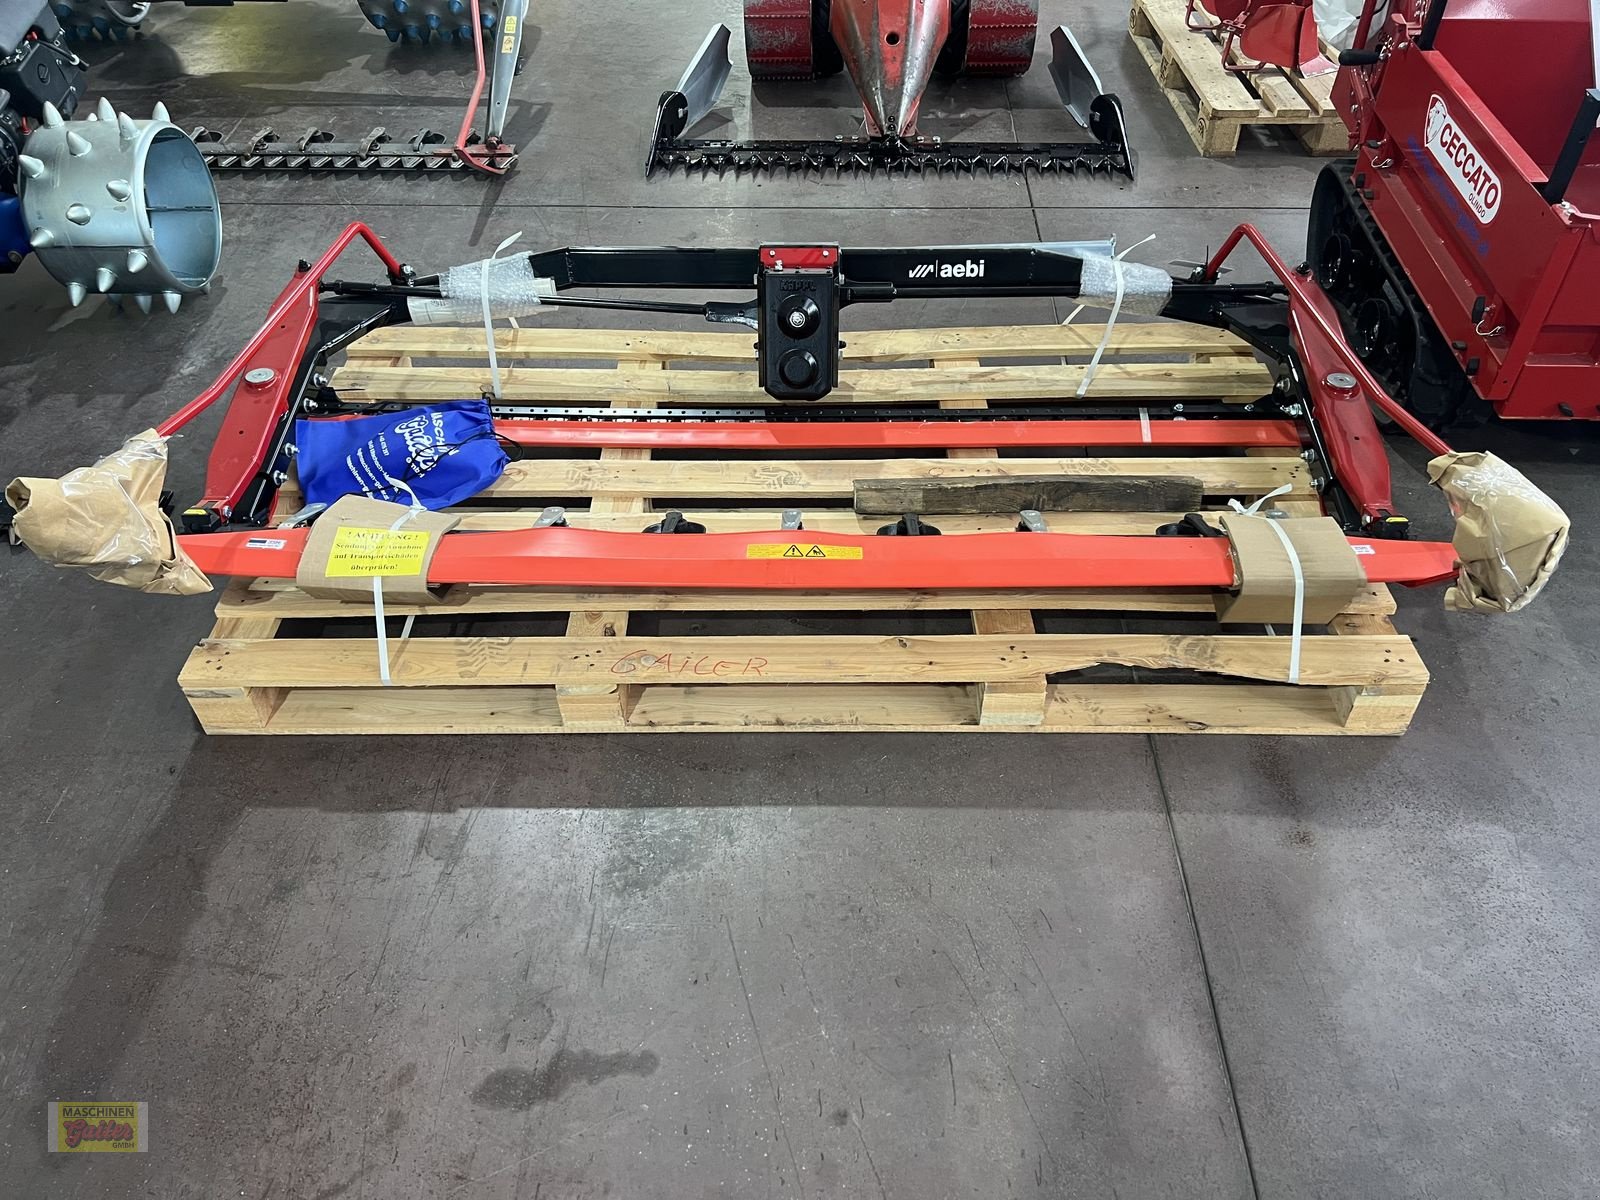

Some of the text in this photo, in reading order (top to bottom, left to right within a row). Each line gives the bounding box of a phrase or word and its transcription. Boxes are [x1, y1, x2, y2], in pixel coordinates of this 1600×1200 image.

[1439, 122, 1499, 210] CECCATO
[1468, 192, 1486, 218] OLINDO
[940, 259, 985, 278] aebi
